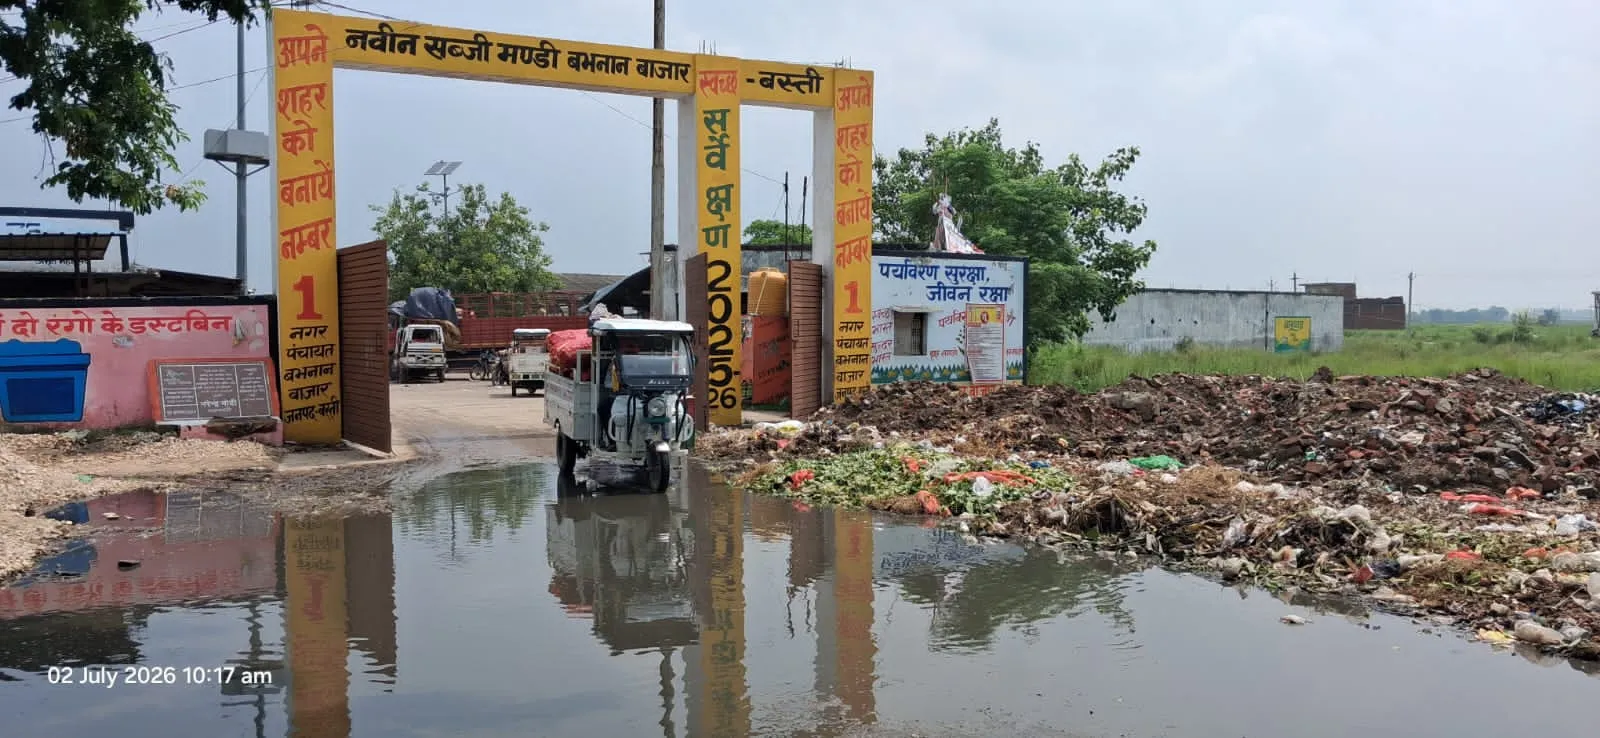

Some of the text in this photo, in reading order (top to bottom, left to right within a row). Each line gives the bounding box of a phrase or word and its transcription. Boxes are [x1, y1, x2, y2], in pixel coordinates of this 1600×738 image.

[278, 24, 329, 68] अपने
[345, 22, 420, 56] नवीन
[424, 33, 493, 62] सब्जी
[497, 39, 561, 69] मण्डी
[567, 50, 632, 76] बभनान
[636, 58, 692, 83] बाजार
[277, 83, 328, 120] शहर
[837, 76, 872, 112] अपने
[281, 120, 318, 156] को
[836, 123, 870, 153] शहर
[839, 153, 863, 187] को
[280, 217, 333, 260] नम्बर
[836, 236, 871, 269] नम्बर
[292, 275, 323, 320] 1
[844, 280, 864, 314] 1
[926, 281, 1010, 303] जीवन रक्षा
[11, 311, 39, 337] दो
[100, 311, 125, 335] के
[128, 309, 233, 335] डस्टबिन
[289, 325, 329, 340] नगर
[838, 321, 864, 334] नगर
[286, 343, 336, 361] पंचायत
[836, 335, 869, 350] पंचायत
